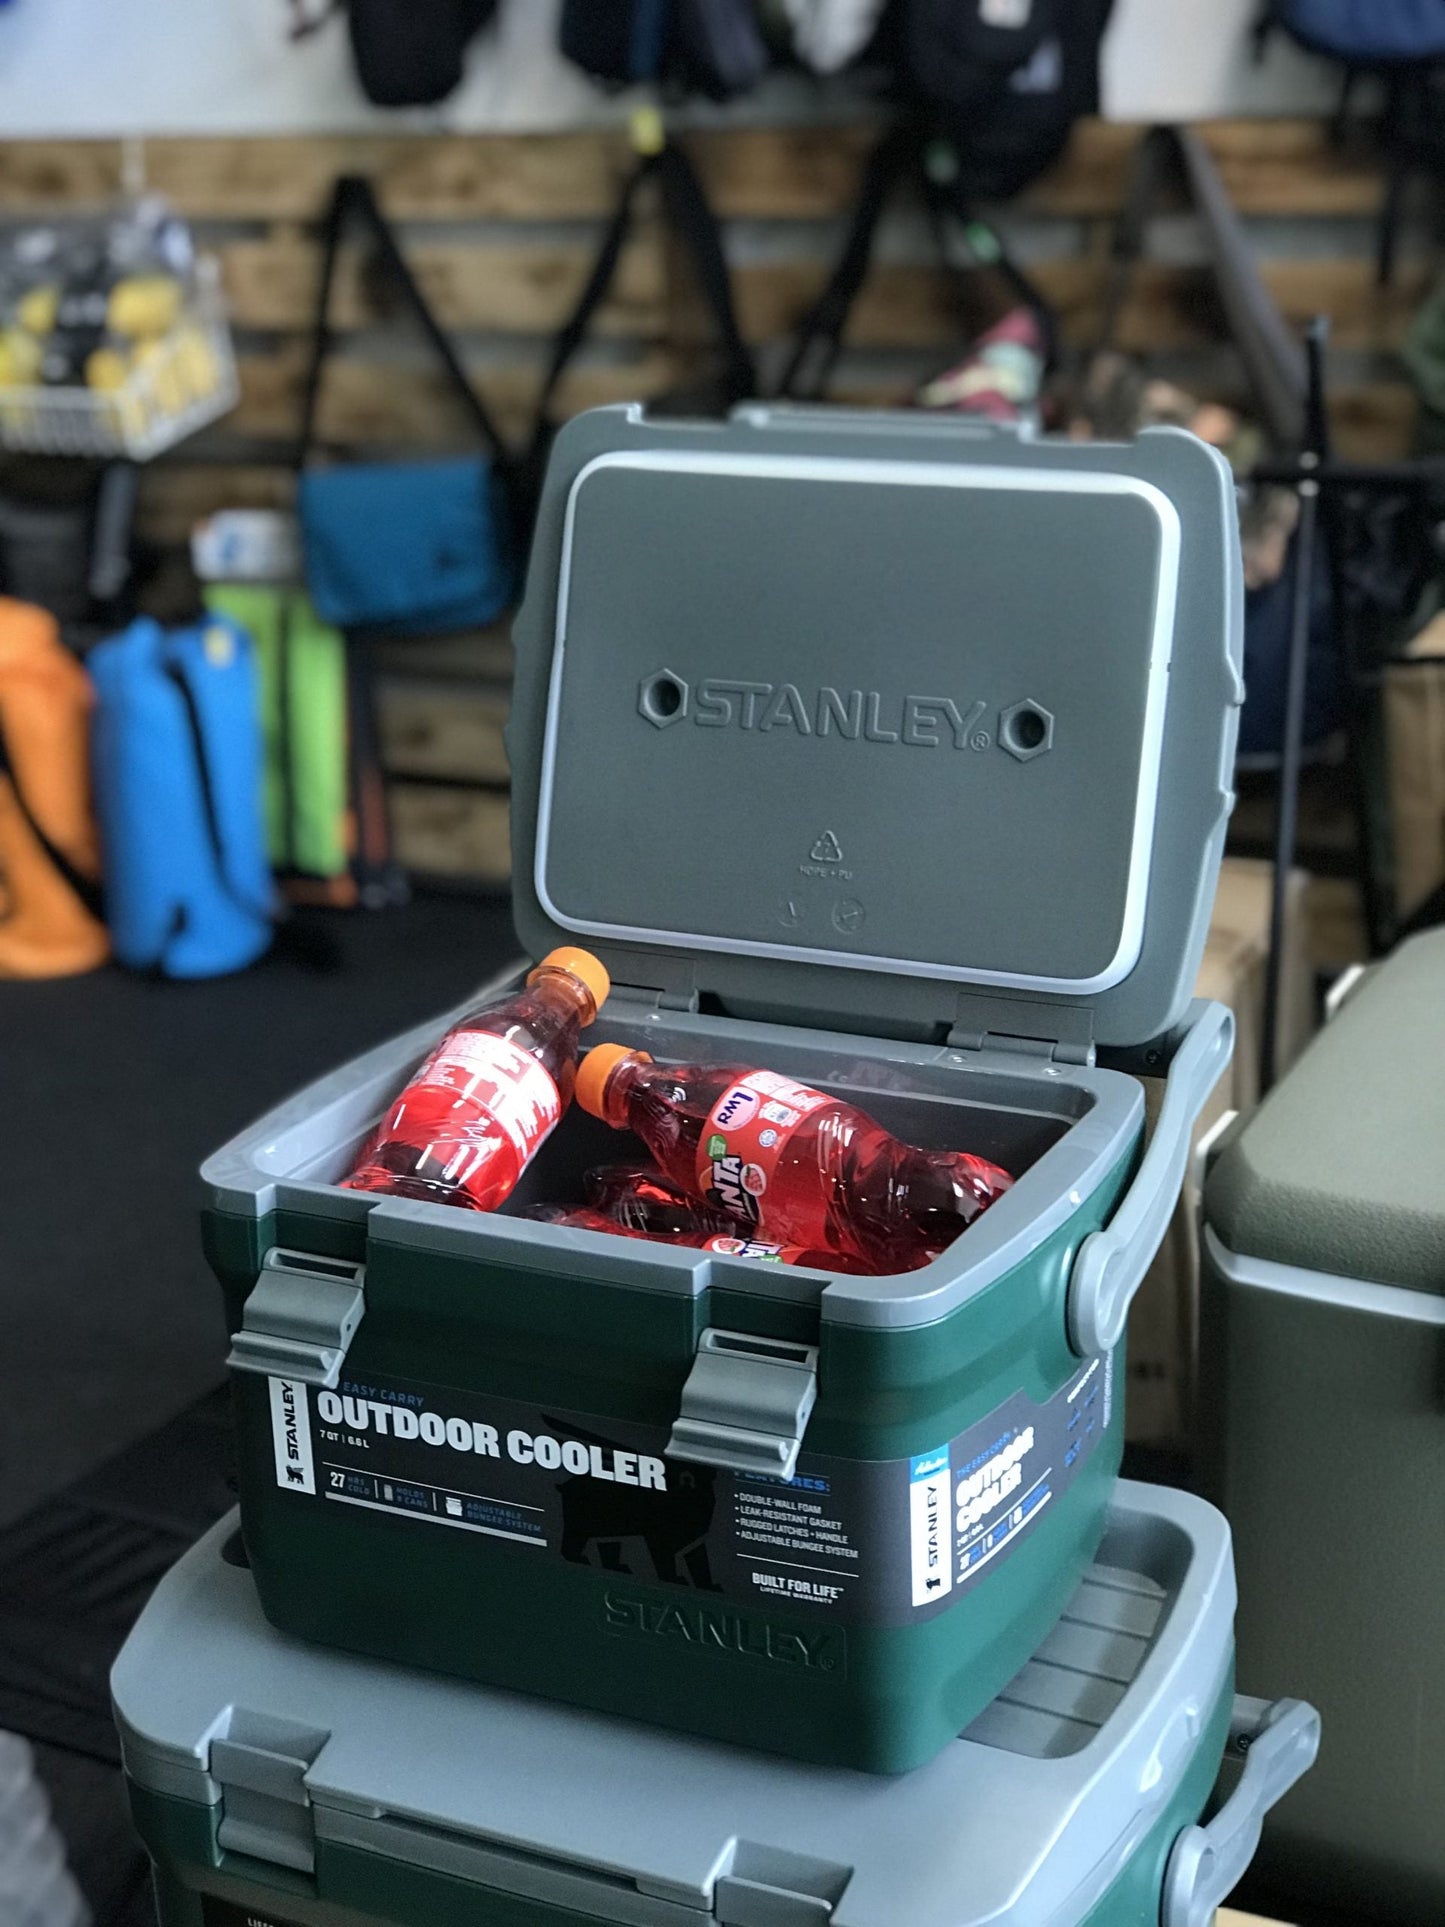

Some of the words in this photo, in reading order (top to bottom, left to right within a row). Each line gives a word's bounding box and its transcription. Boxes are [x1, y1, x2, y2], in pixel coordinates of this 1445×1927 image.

[717, 1090, 754, 1126] RM1
[343, 1381, 376, 1398] EASY
[380, 1389, 424, 1408] CARRY
[283, 1381, 300, 1462] STANLEY
[317, 1390, 501, 1459] OUTDOOR
[507, 1430, 668, 1492] COOLER
[319, 1429, 326, 1439] 7
[326, 1431, 340, 1442] QT
[329, 1471, 346, 1489] 27
[739, 1492, 797, 1511] DOUBLE-WALL
[797, 1502, 822, 1515] FOAM
[740, 1505, 808, 1525] LEAK-RESISTANT
[808, 1517, 843, 1531] GASKET
[740, 1518, 773, 1531] RUGGED
[773, 1521, 810, 1538] LATCHES
[814, 1530, 849, 1545] HANDLE
[927, 1485, 938, 1568] STANLEY
[740, 1530, 792, 1547] ADJUSTABLE
[791, 1539, 825, 1553] BUNGEE
[825, 1544, 860, 1559] SYSTEM
[751, 1571, 786, 1589] BUILT
[787, 1578, 811, 1594] FOR
